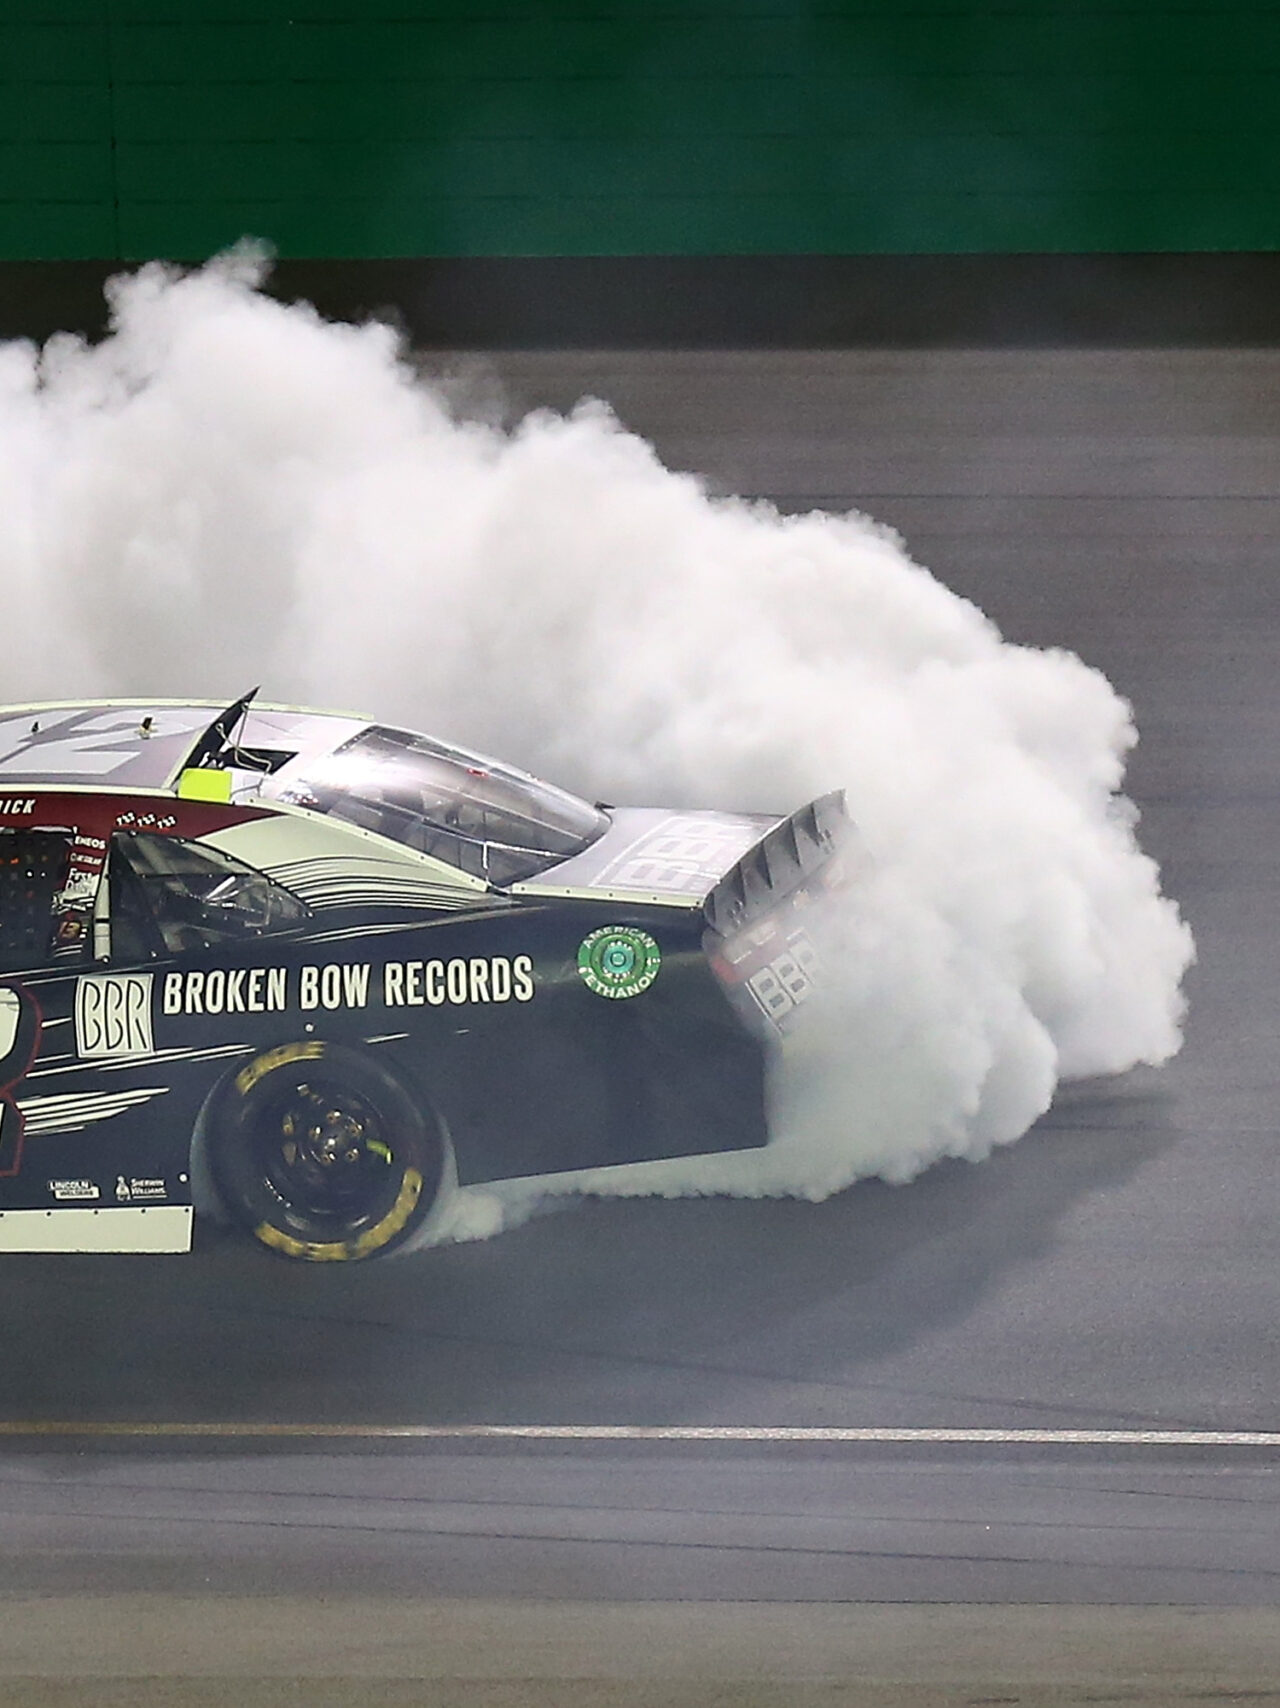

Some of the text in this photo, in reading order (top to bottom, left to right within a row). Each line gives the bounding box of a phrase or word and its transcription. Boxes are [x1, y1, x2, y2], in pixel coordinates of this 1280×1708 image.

[581, 926, 657, 950] AMERICAN
[163, 956, 535, 1015] BROKEN BOW RECORDS
[584, 970, 657, 999] ETHANOL
[82, 980, 148, 1052] BBR
